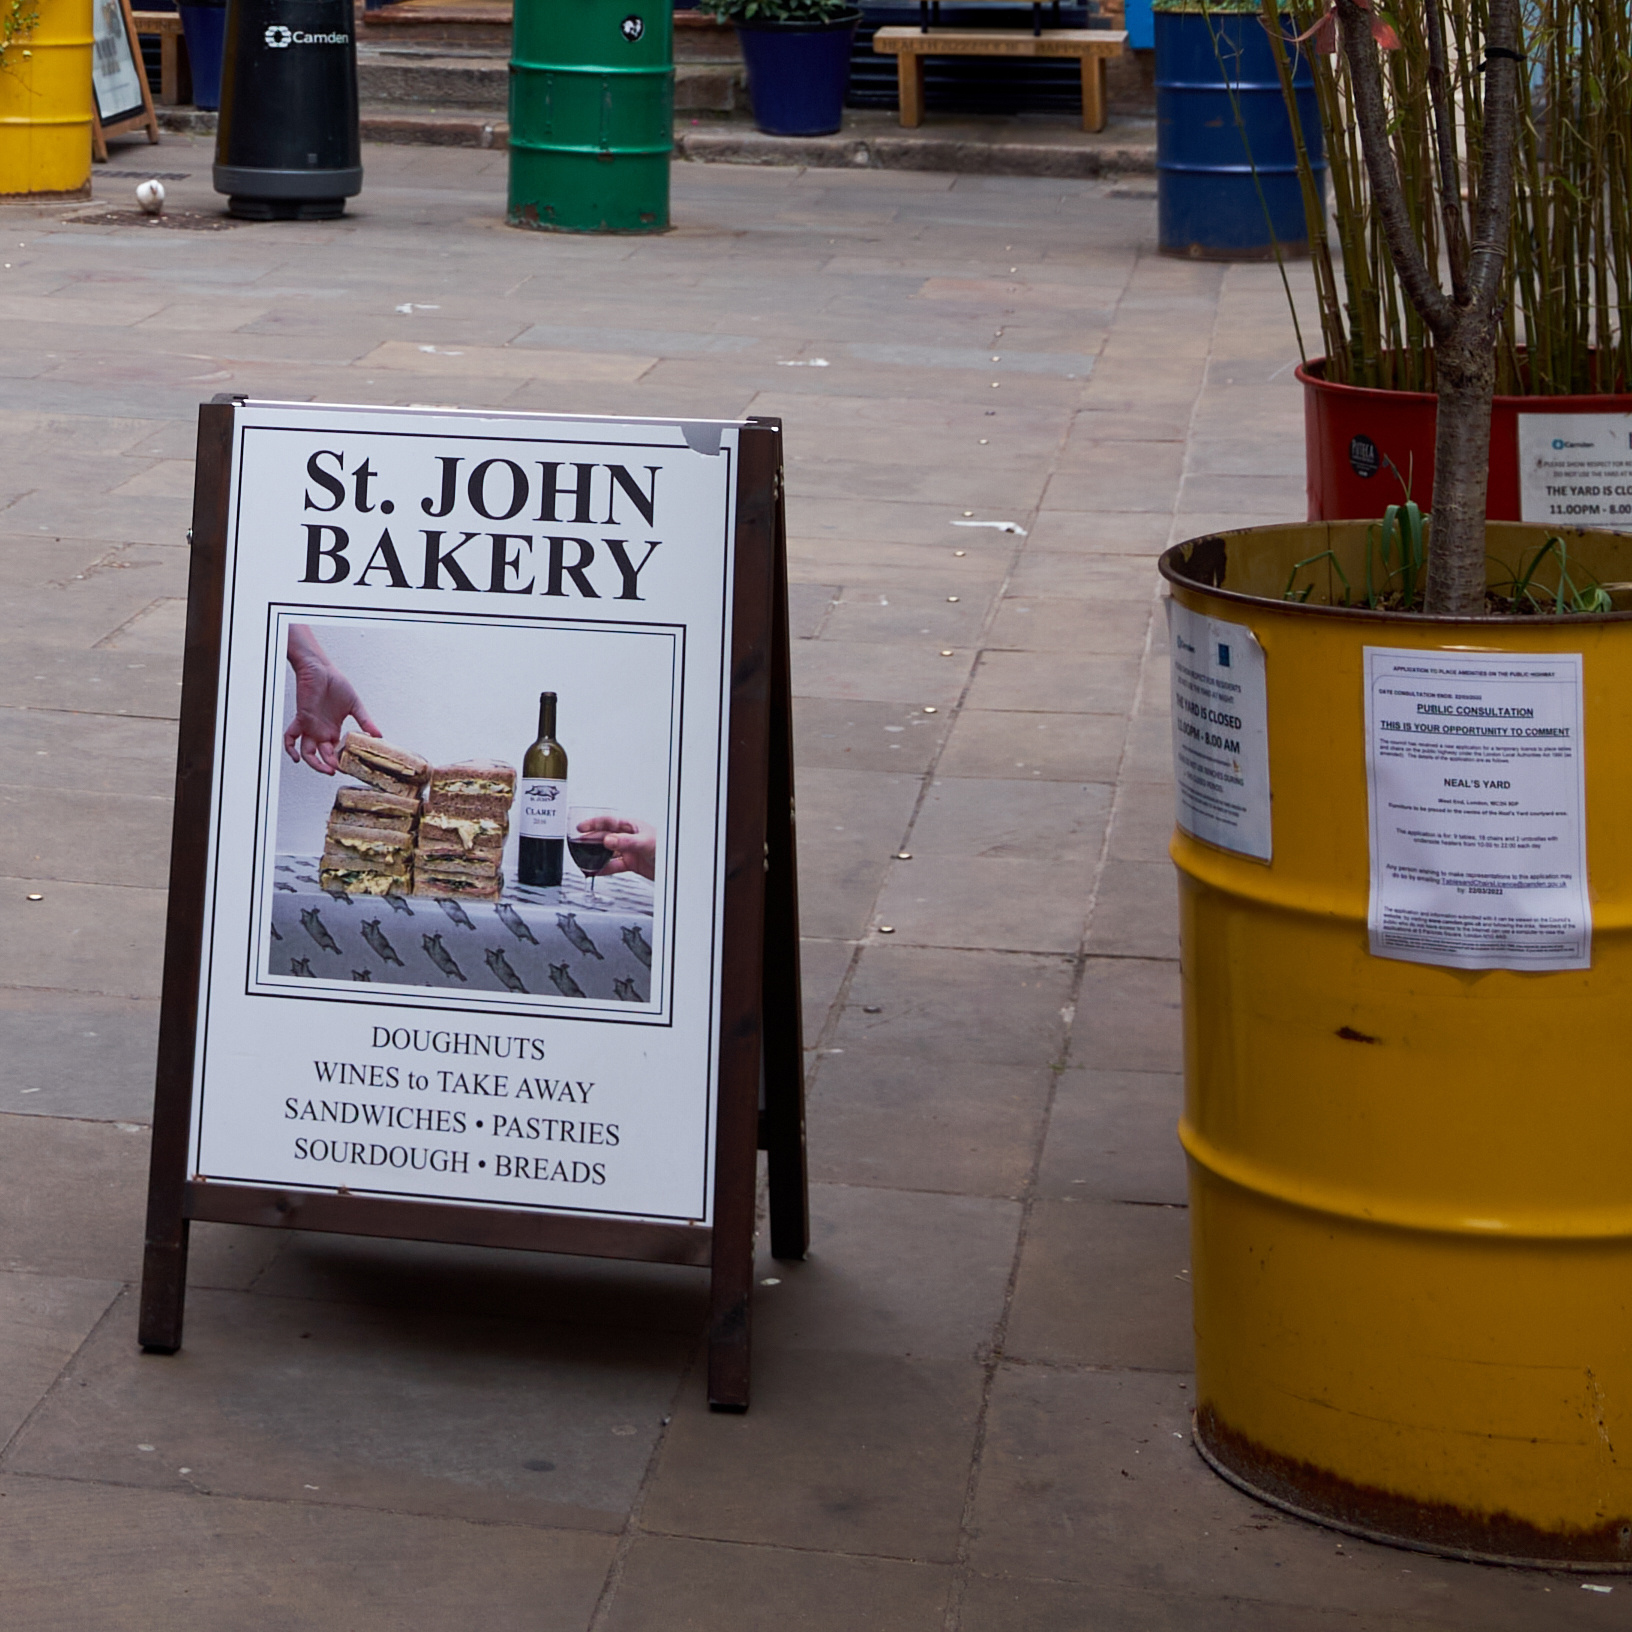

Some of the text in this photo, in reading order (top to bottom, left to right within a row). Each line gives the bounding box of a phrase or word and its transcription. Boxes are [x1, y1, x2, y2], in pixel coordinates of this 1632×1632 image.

[292, 31, 349, 45] Camden
[303, 449, 663, 528] St. JOHN
[1547, 486, 1567, 496] THE
[1570, 486, 1600, 496] YARD
[1603, 486, 1613, 496] IS
[297, 523, 663, 601] BAKERY
[1417, 703, 1533, 717] PUBLIC CONSULTATION
[1208, 710, 1242, 729] CLOSED
[1381, 720, 1570, 737] THIS IS YOUR OPPORTUNITY TO COMMENT
[1224, 738, 1240, 754] AM
[1444, 778, 1511, 789] NEAL'S YARD
[525, 807, 556, 817] CLARET
[372, 1026, 545, 1061] DOUGHNUTS
[314, 1060, 595, 1104] WINES to TAKE AWAY
[284, 1097, 620, 1147] SANDWICHES PASTRIES
[294, 1137, 606, 1185] SOURDOUGH BREADS
